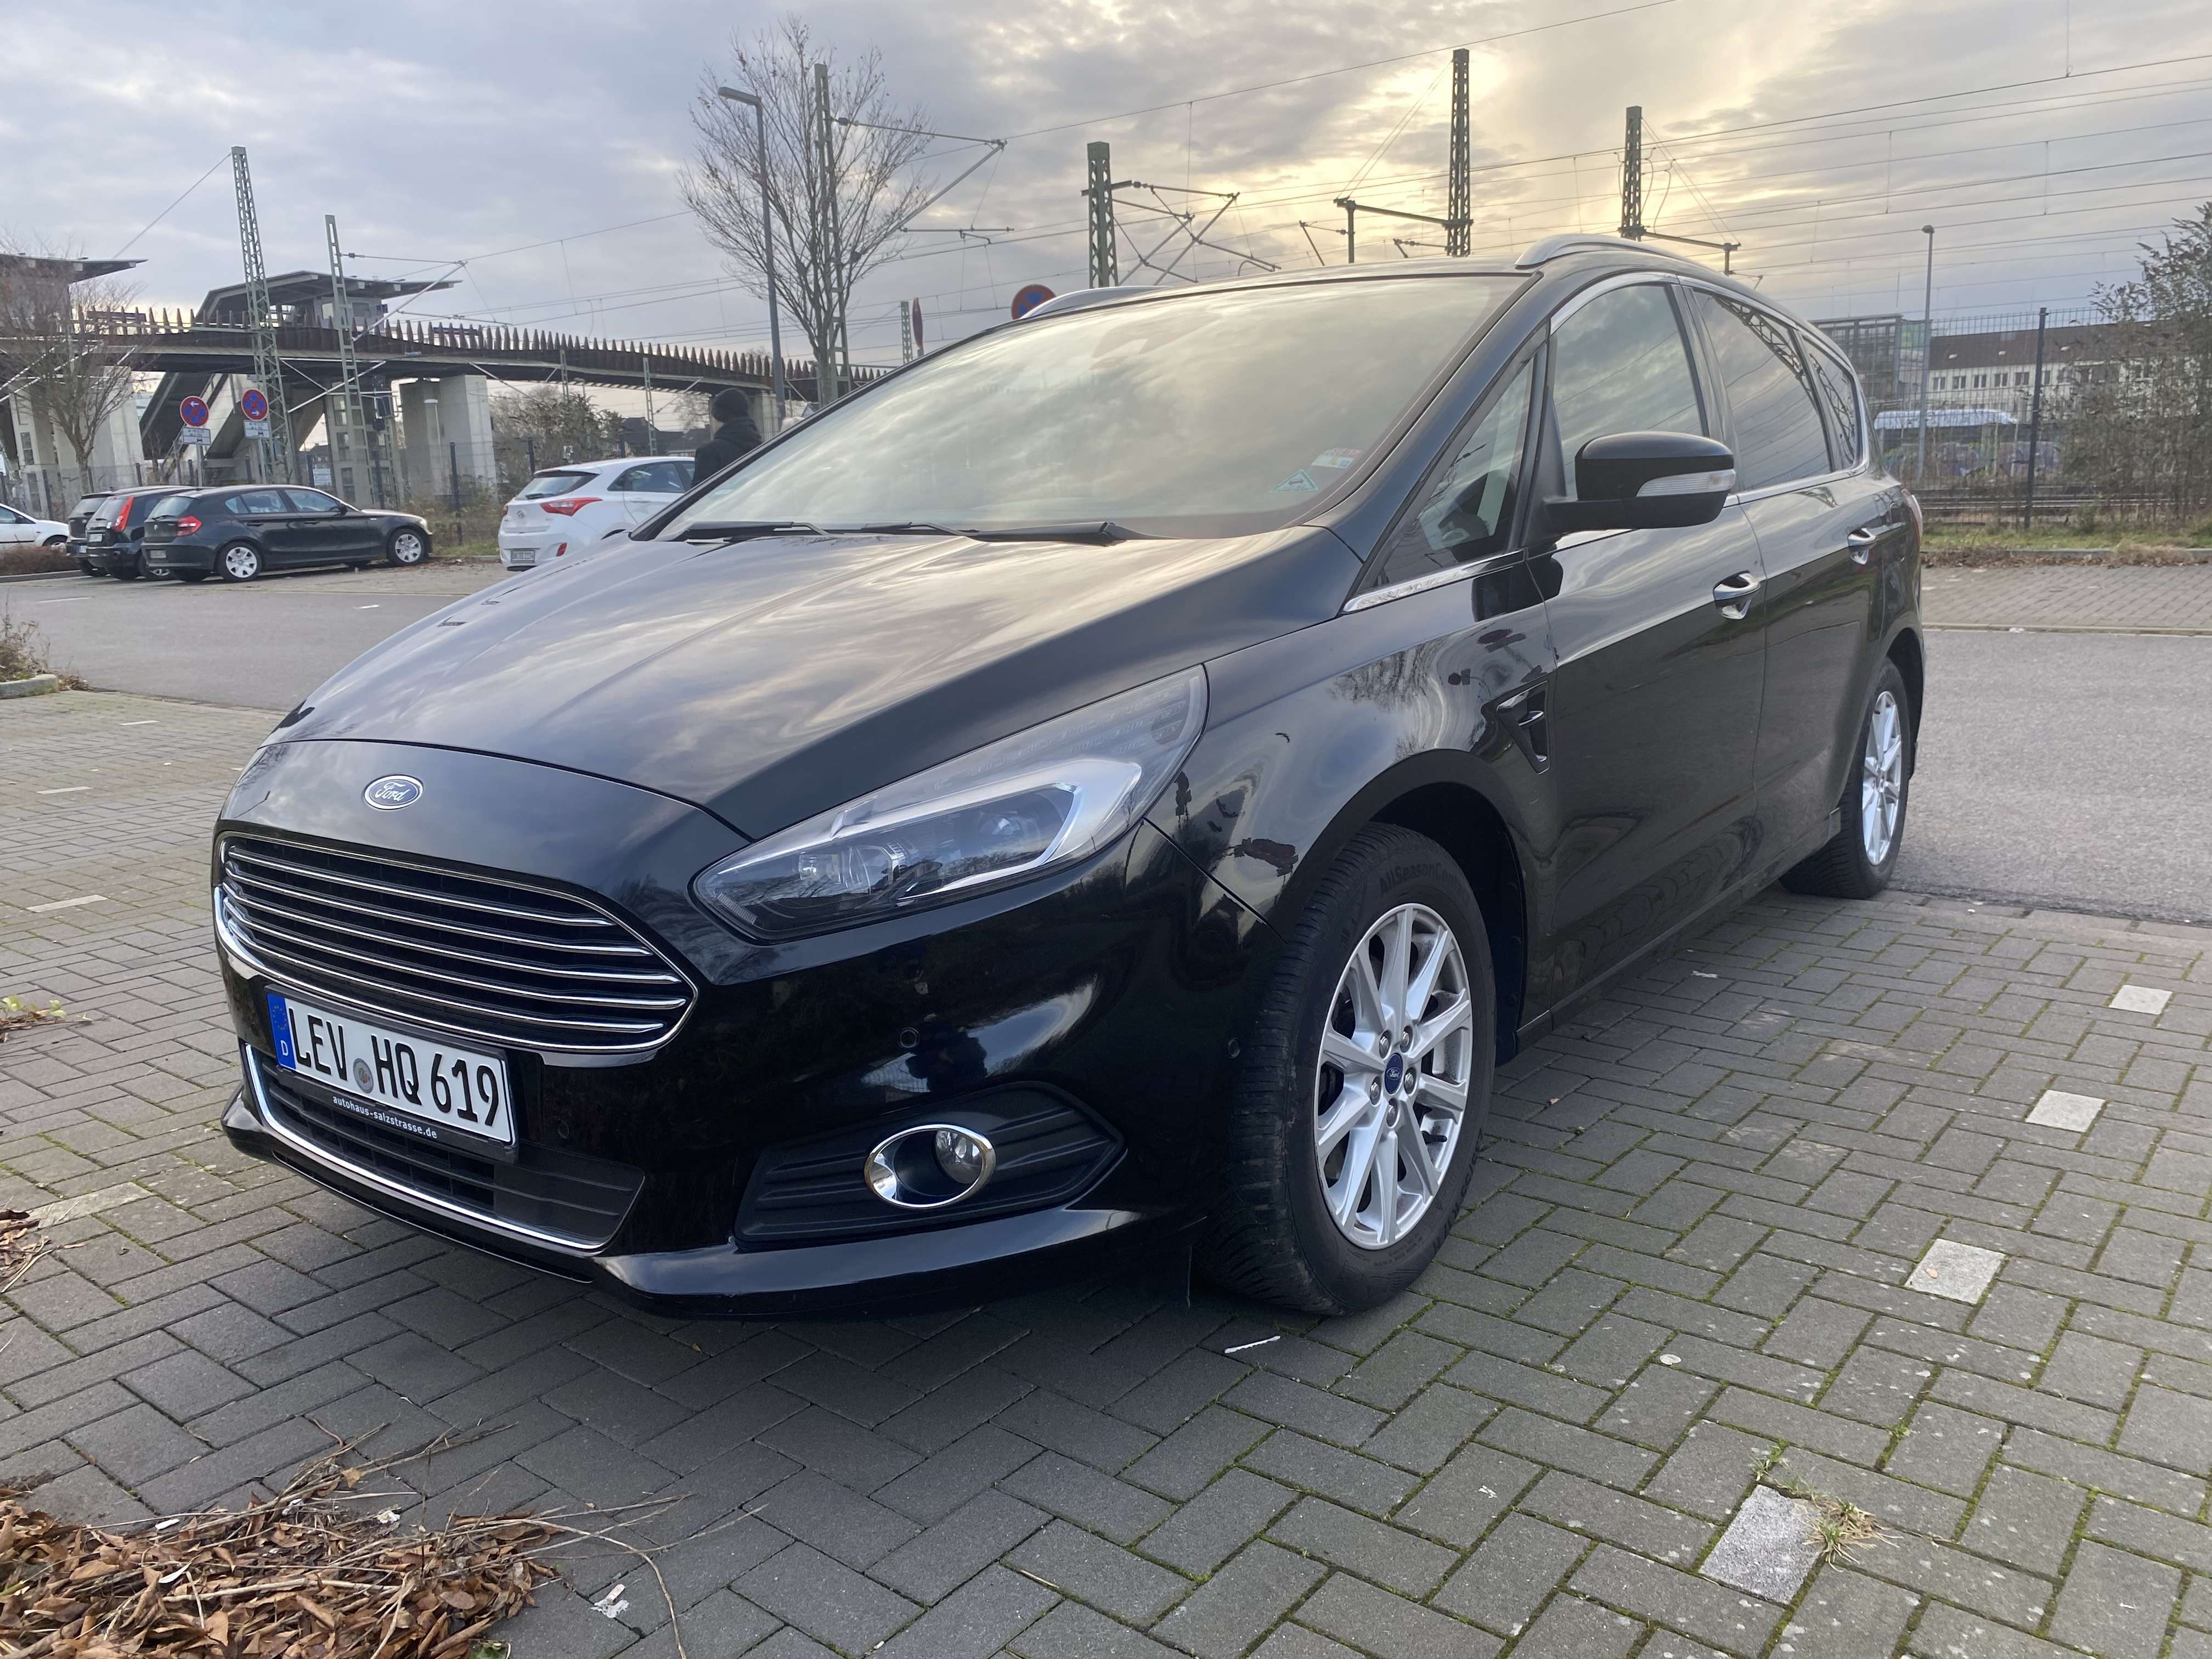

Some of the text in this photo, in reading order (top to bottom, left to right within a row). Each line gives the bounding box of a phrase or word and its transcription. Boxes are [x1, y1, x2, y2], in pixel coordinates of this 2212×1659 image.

[375, 781, 410, 802] Ford
[280, 1040, 289, 1056] D
[289, 1008, 499, 1127] LEV HQ 619
[332, 1095, 438, 1139] autohaus-salzstrasse.de
